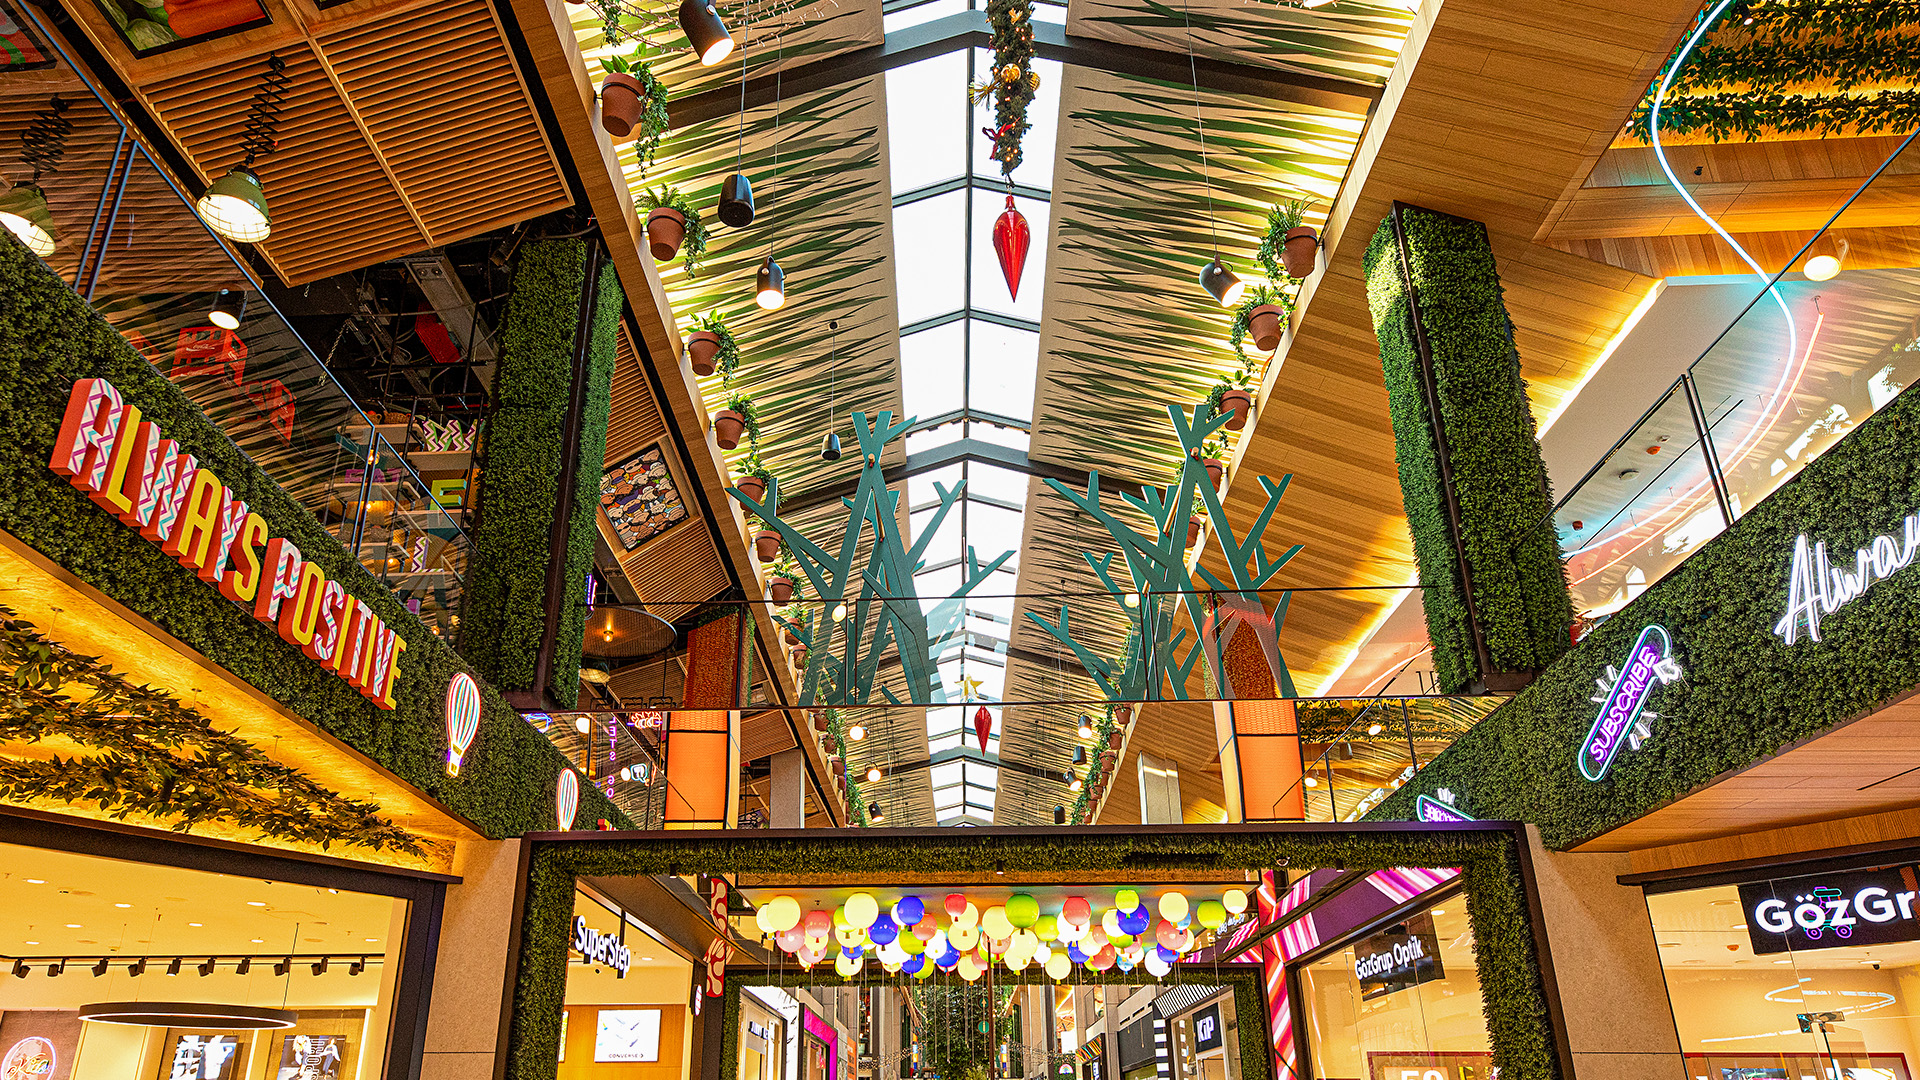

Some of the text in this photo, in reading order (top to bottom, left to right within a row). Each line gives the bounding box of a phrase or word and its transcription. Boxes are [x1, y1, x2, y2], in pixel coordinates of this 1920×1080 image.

[50, 378, 407, 711] ALWAYS POSITIVE
[1590, 645, 1658, 761] SUBSCRIBE
[1754, 886, 1920, 934] GözGr
[574, 915, 631, 979] SuperStep
[1354, 935, 1424, 980] GözGrup Optik
